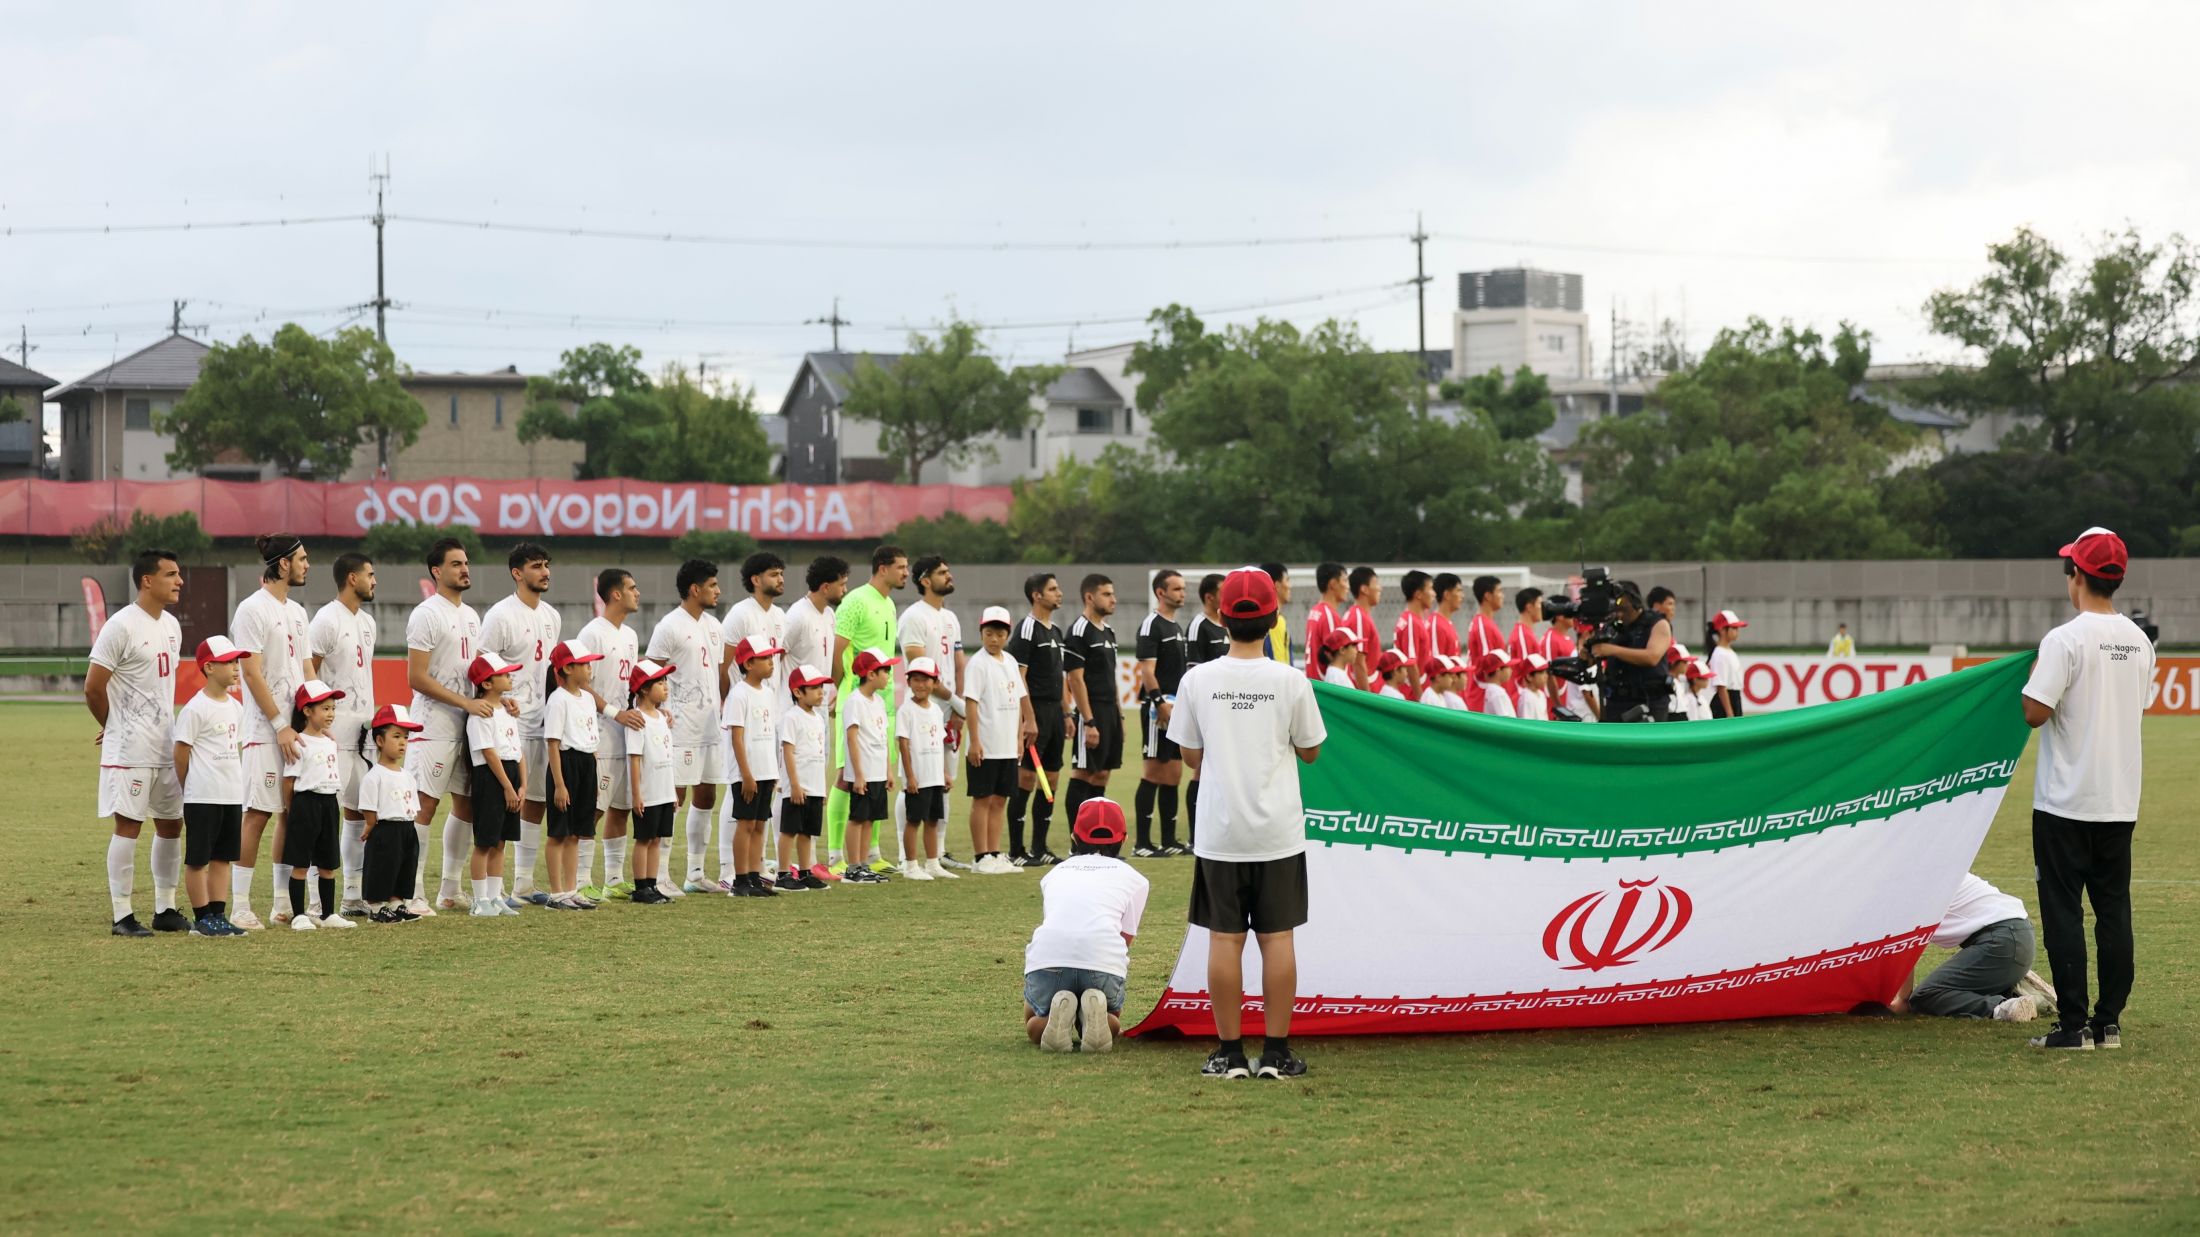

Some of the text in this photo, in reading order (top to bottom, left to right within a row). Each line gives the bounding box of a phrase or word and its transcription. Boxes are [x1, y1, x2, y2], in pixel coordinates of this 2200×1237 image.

[461, 637, 469, 659] 11
[534, 640, 542, 661] 8
[941, 635, 948, 655] 5
[2100, 644, 2141, 654] Aichi-Nagoya
[157, 652, 170, 678] 10
[357, 645, 364, 667] 9
[701, 646, 708, 667] 2
[619, 659, 631, 681] 20
[1212, 692, 1275, 703] Aichi-Nagoya
[1232, 702, 1255, 710] 2026
